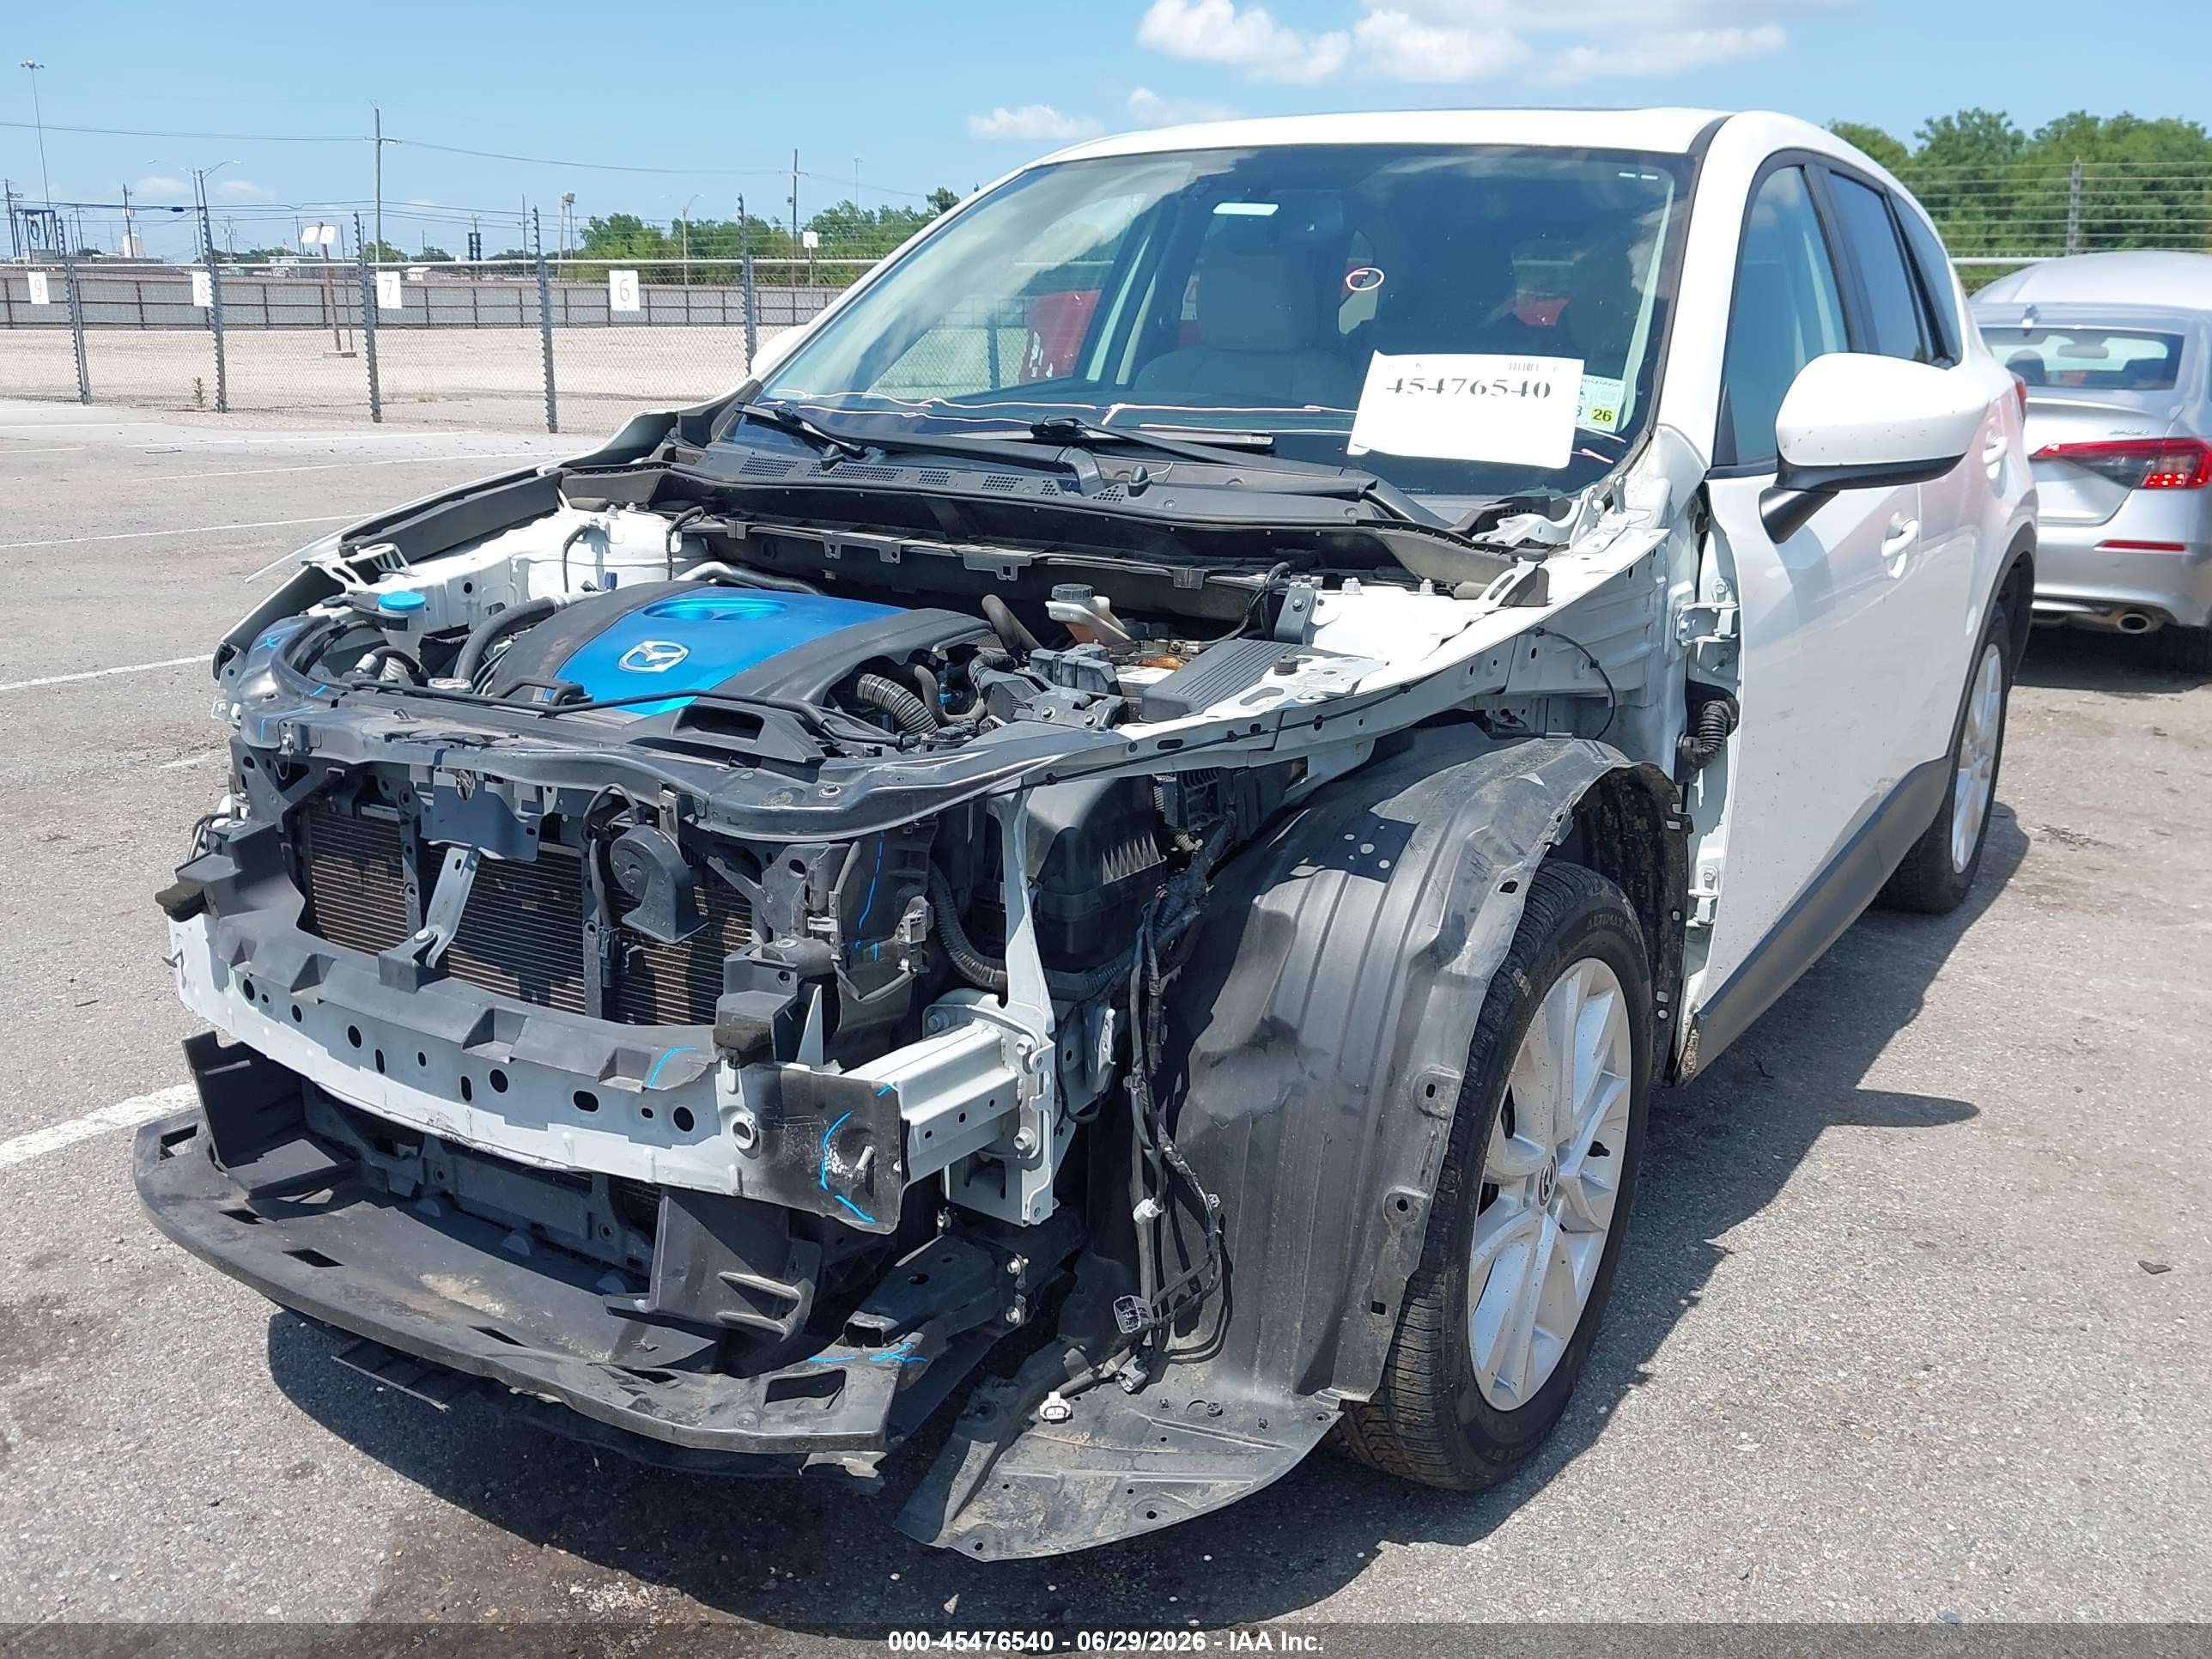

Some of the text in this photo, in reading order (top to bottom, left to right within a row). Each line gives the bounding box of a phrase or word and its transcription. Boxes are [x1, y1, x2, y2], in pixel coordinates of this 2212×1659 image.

[34, 279, 42, 297] 9
[199, 279, 208, 299] 8
[383, 279, 393, 301] 7
[619, 278, 630, 301] 6
[1386, 377, 1551, 399] 45476540
[1592, 408, 1613, 422] 26
